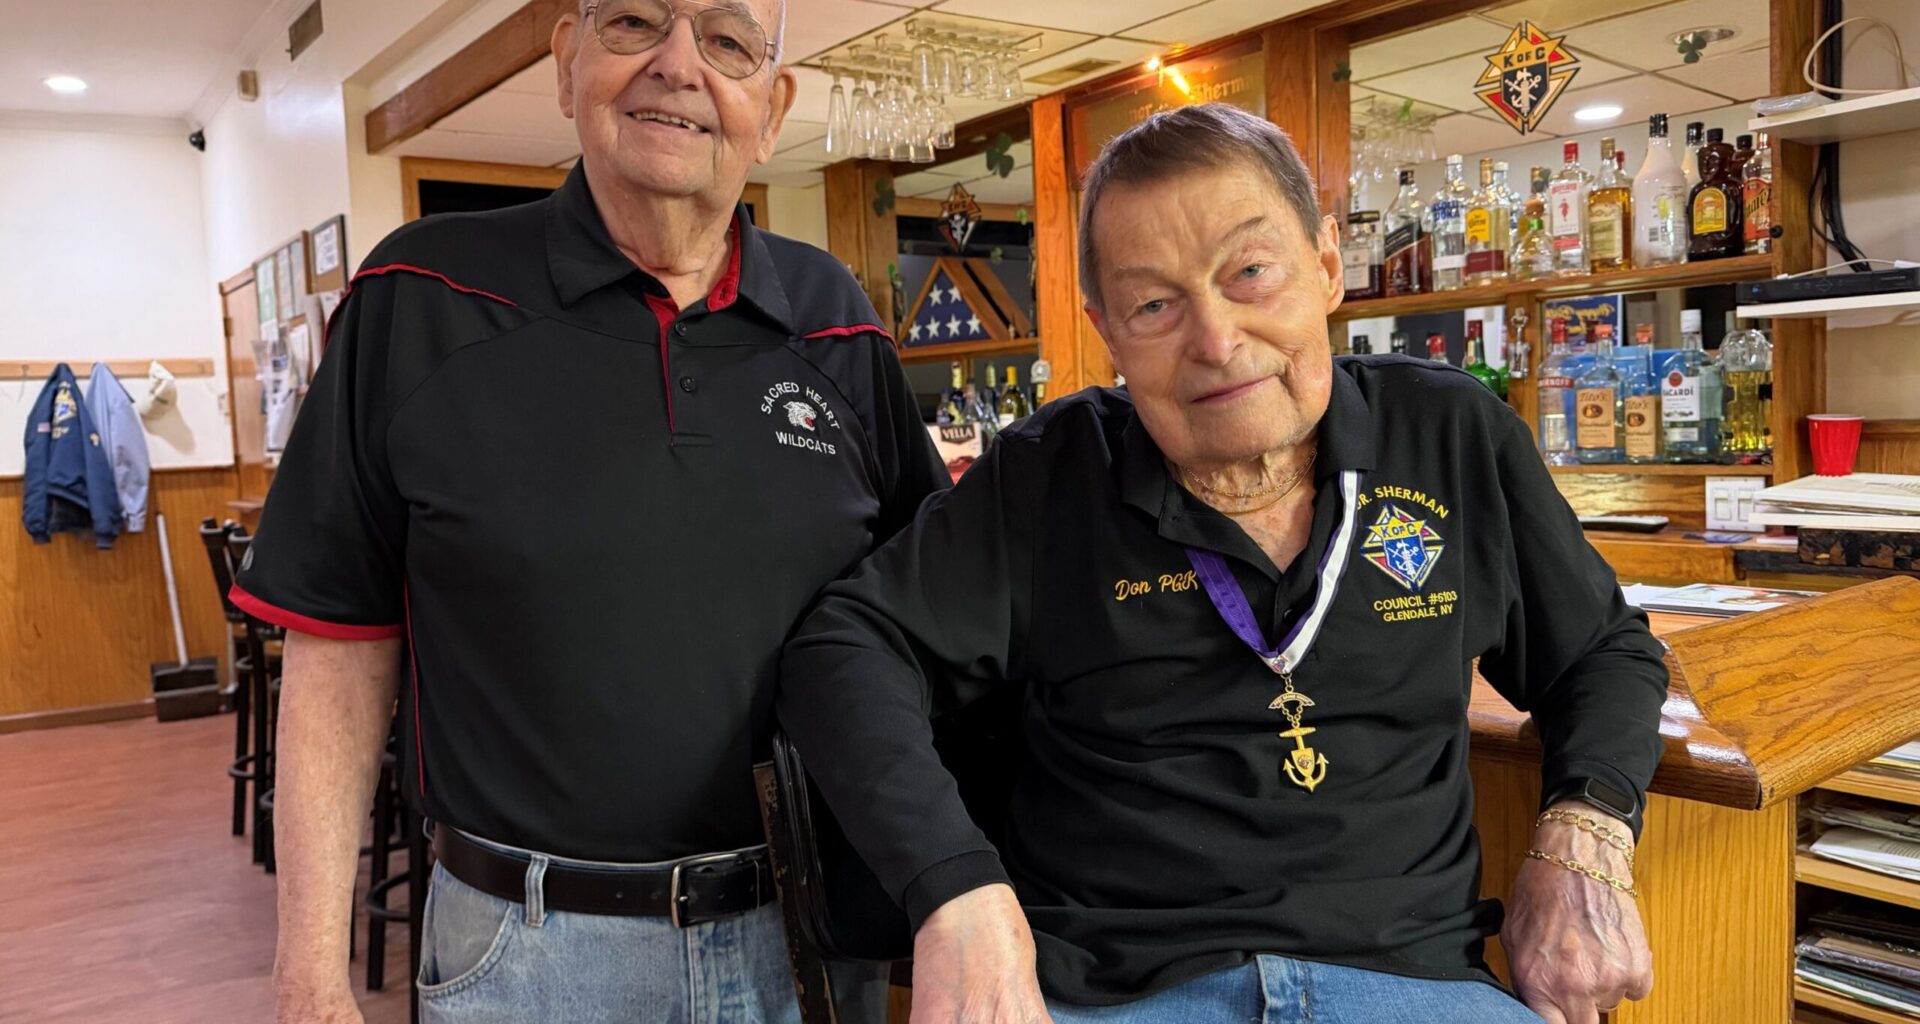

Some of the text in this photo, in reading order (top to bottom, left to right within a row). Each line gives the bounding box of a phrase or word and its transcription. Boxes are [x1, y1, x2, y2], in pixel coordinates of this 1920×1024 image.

[1503, 54, 1514, 68] K
[1535, 47, 1545, 60] C
[761, 381, 841, 429] SACRED HEART
[775, 431, 836, 455] WILDCATS
[942, 426, 973, 440] VELLA
[1374, 485, 1449, 519] SHERMAN
[1381, 527, 1392, 538] K
[1406, 523, 1416, 535] C
[1115, 570, 1198, 601] Don PGK
[1373, 595, 1426, 612] COUNCIL
[1383, 604, 1453, 622] GLENDALE, NY
